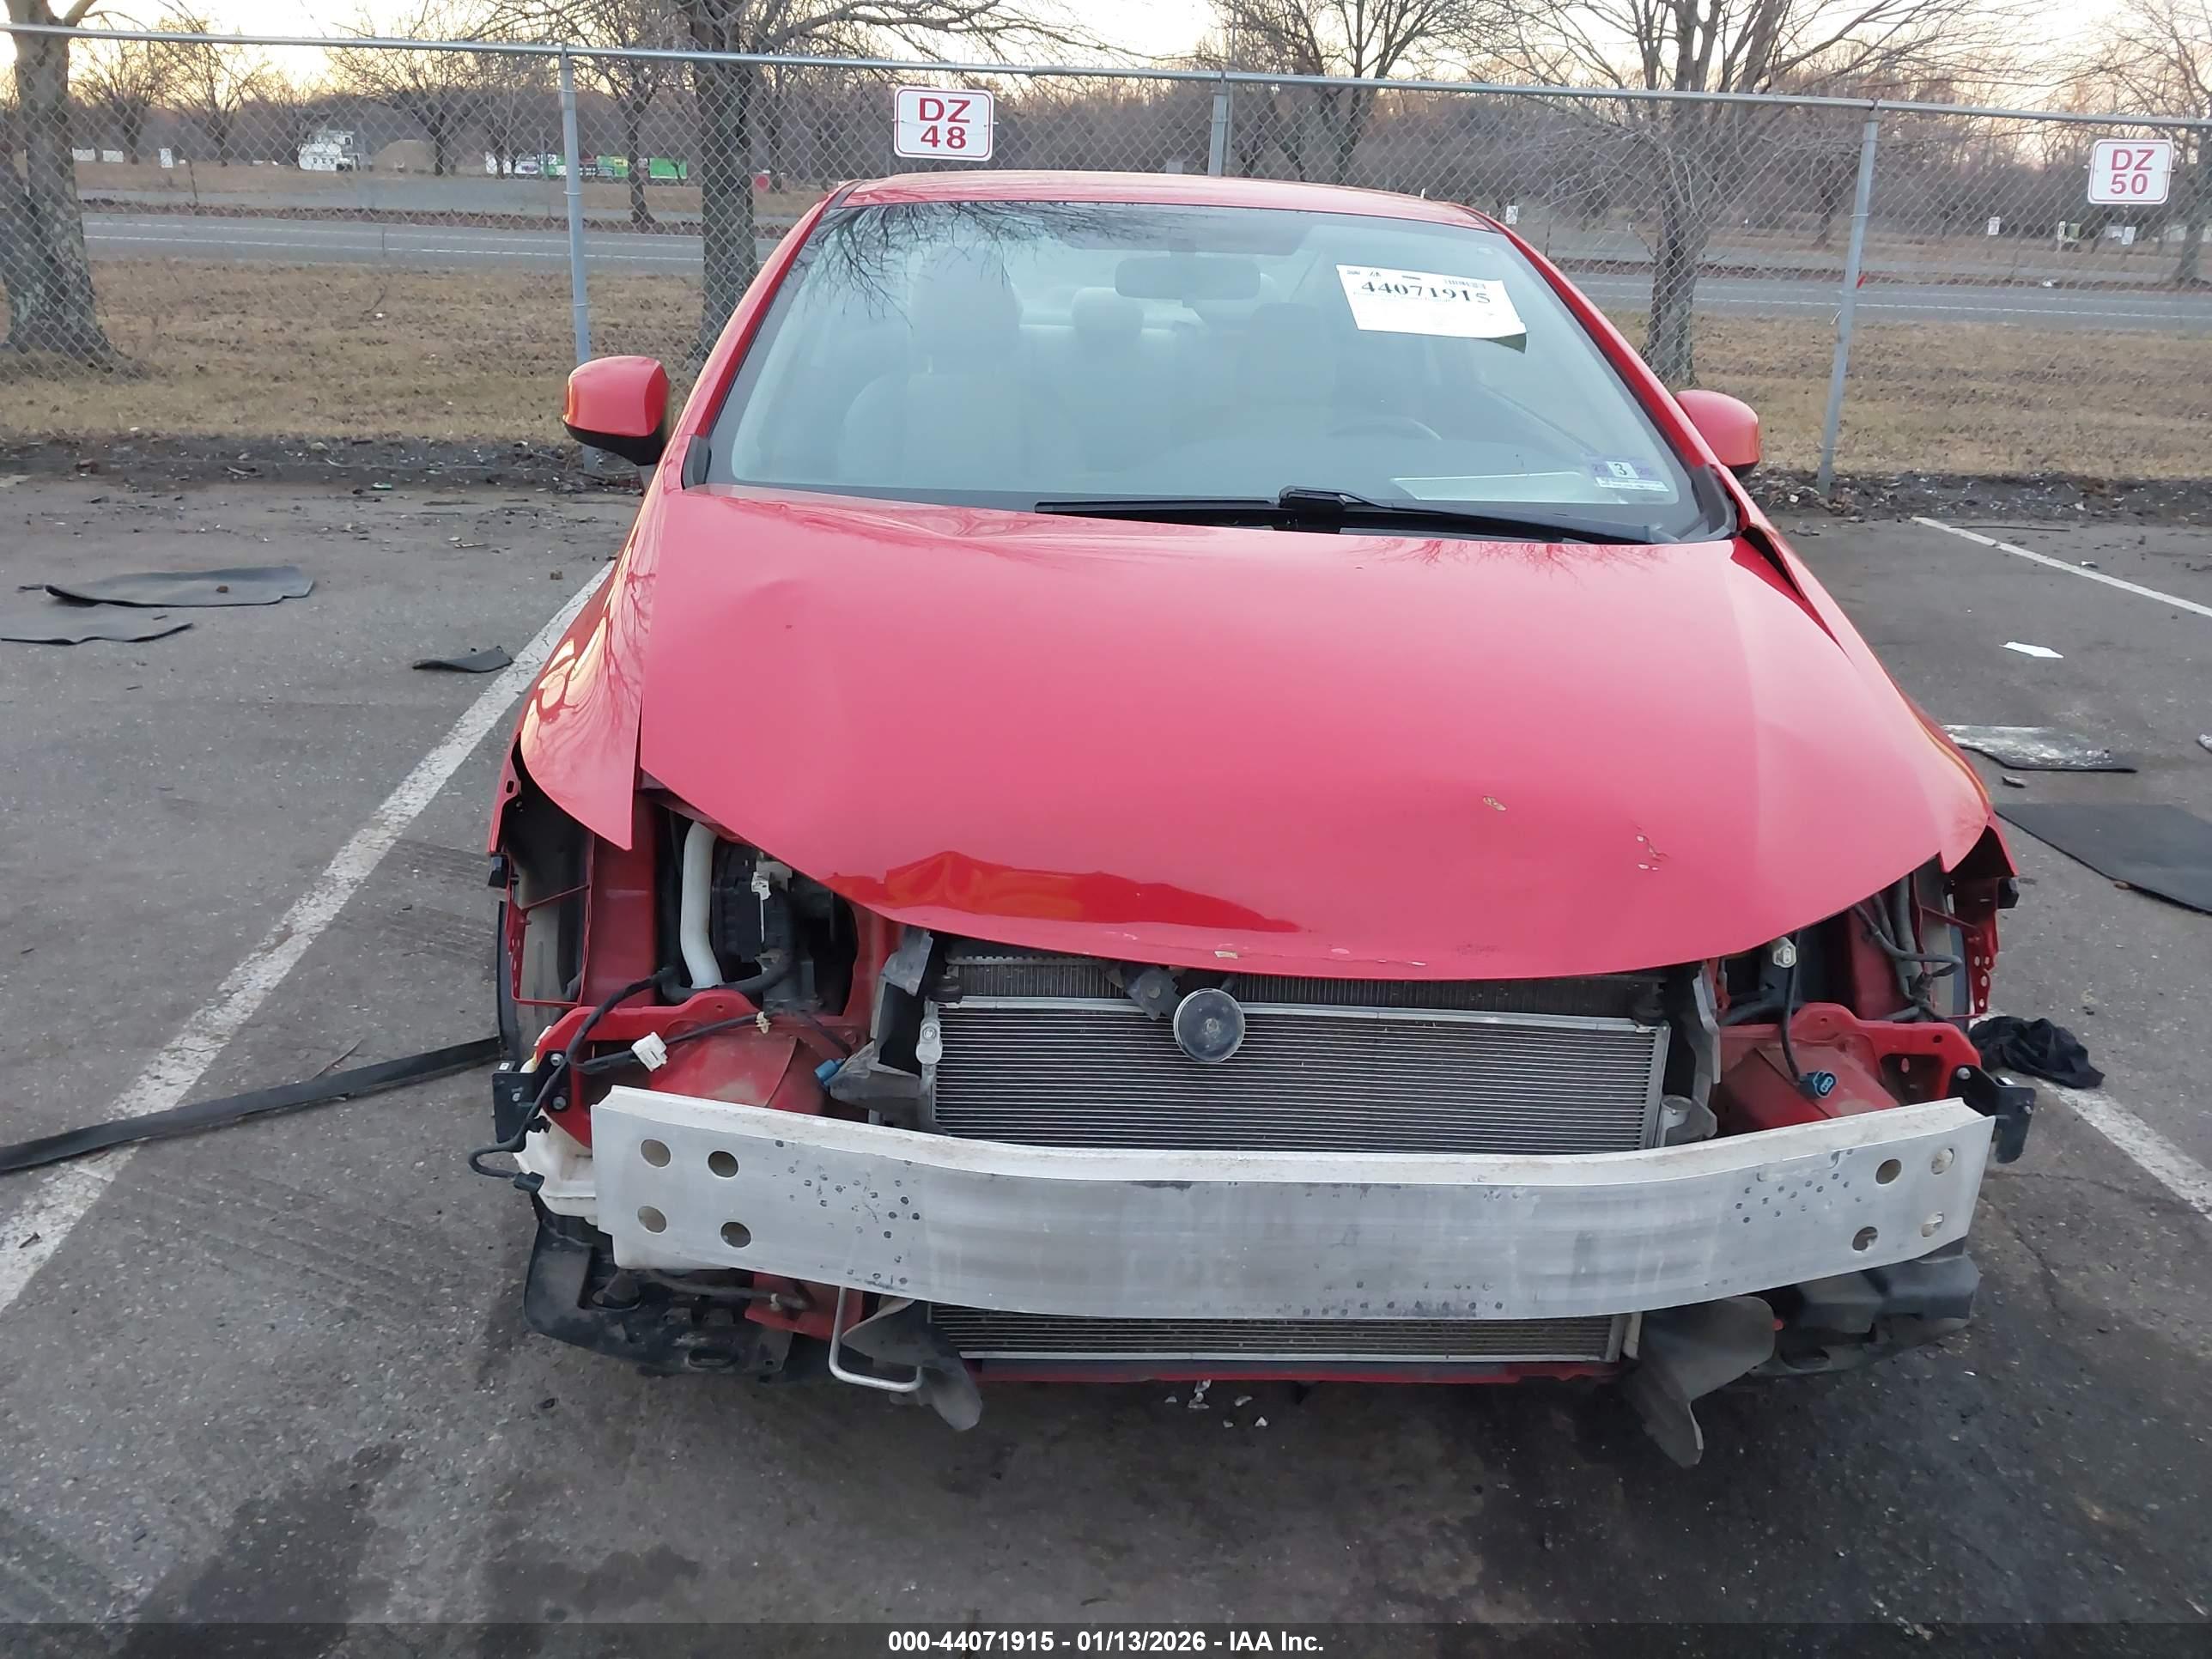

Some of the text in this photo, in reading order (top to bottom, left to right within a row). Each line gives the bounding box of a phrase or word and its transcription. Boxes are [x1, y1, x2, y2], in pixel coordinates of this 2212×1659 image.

[919, 97, 971, 124] DZ
[920, 125, 967, 149] 48
[2111, 149, 2155, 171] DZ
[2110, 173, 2148, 195] 50
[1613, 463, 1628, 476] 3
